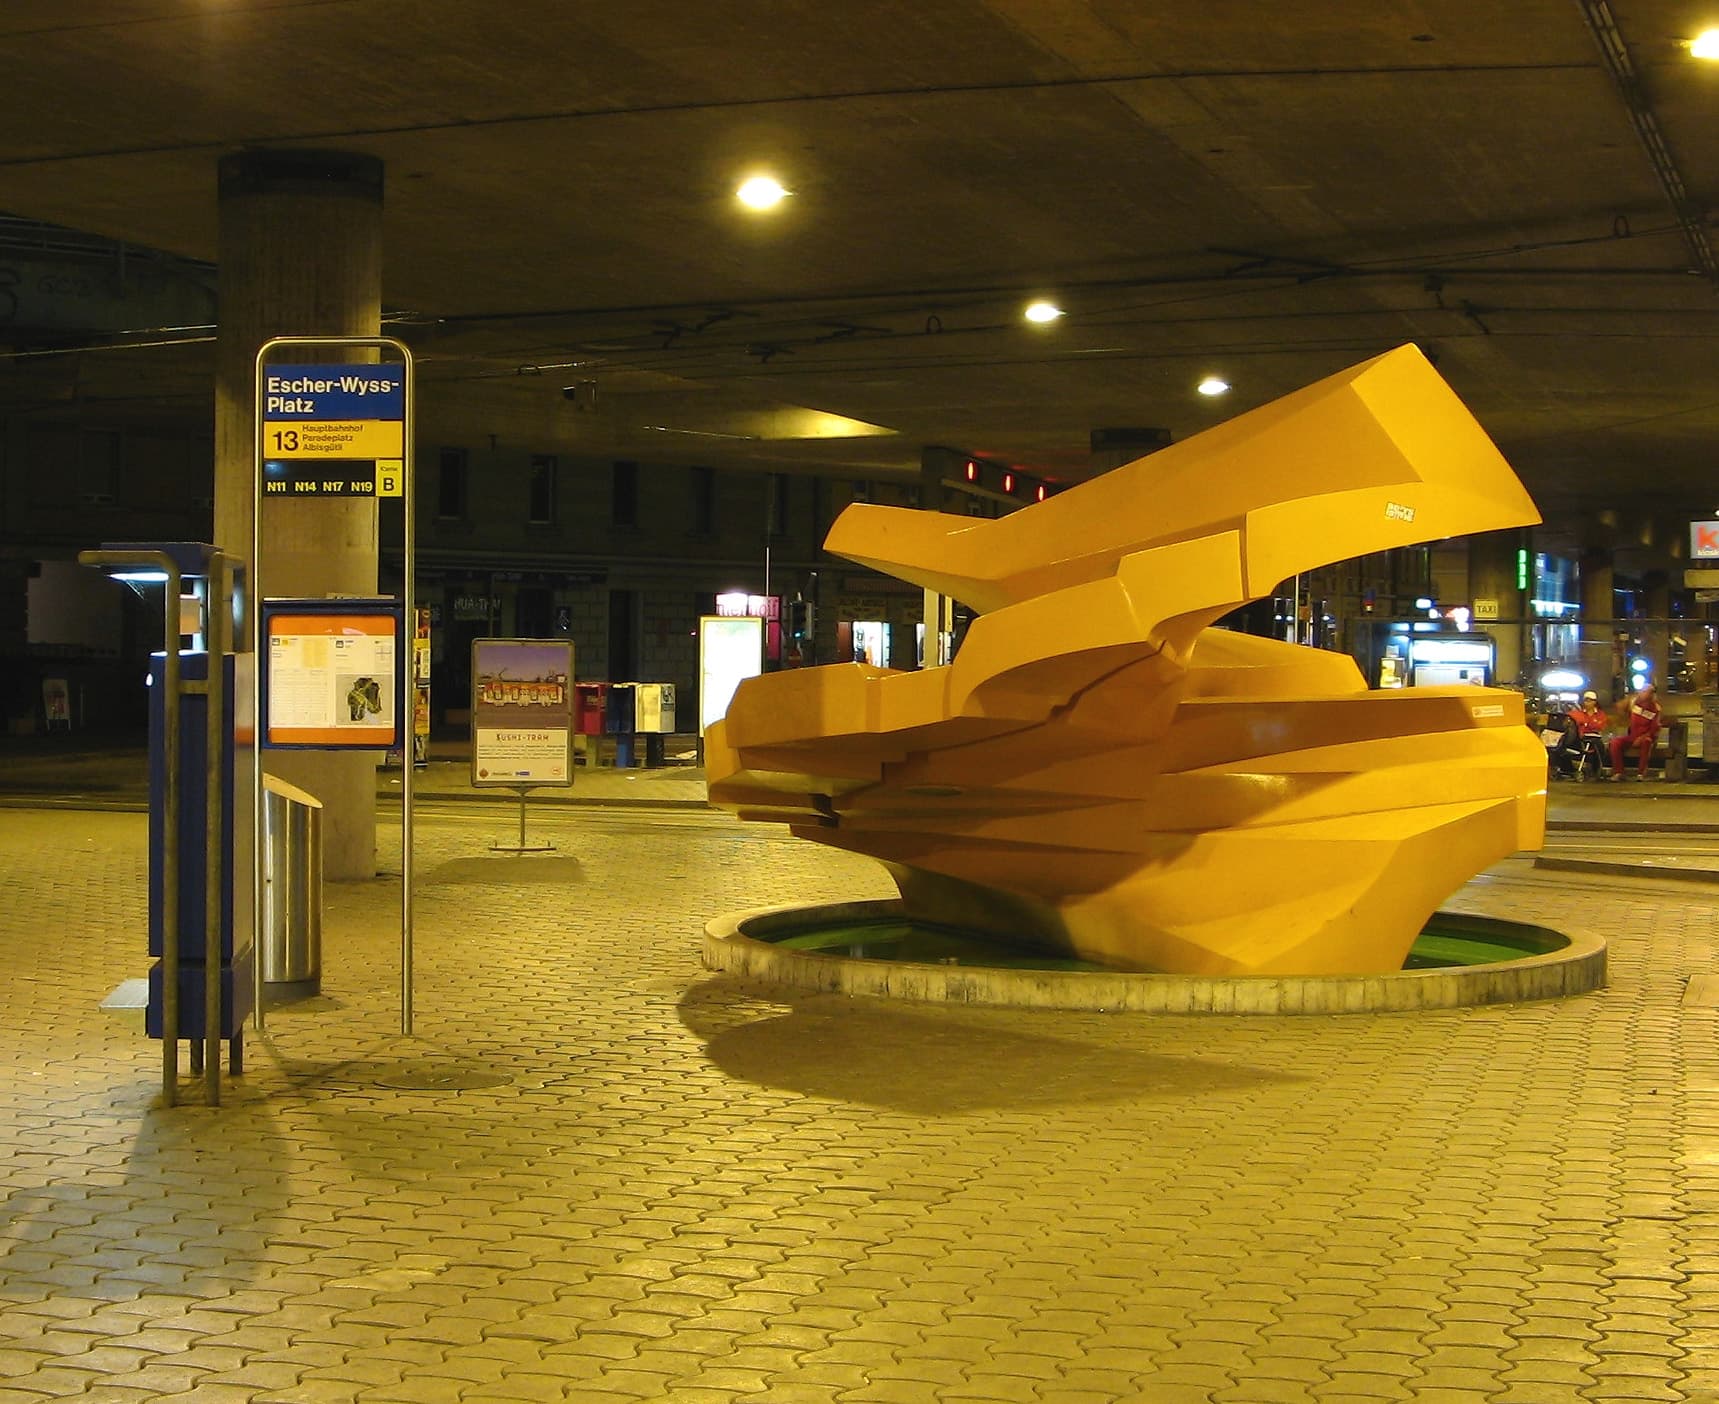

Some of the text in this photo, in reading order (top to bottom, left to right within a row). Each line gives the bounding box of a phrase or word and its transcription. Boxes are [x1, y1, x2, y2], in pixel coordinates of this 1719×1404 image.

[267, 376, 399, 396] Escher-Wyss-
[267, 397, 314, 413] Platz
[302, 424, 364, 433] Hauptbahnhof
[272, 430, 299, 451] 13
[302, 434, 353, 442] Paradeplatz
[267, 481, 373, 492] N11 N14 N17 N19
[383, 477, 395, 491] B
[1476, 605, 1497, 614] TAXI
[496, 733, 549, 742] SUSHI-TRAM
